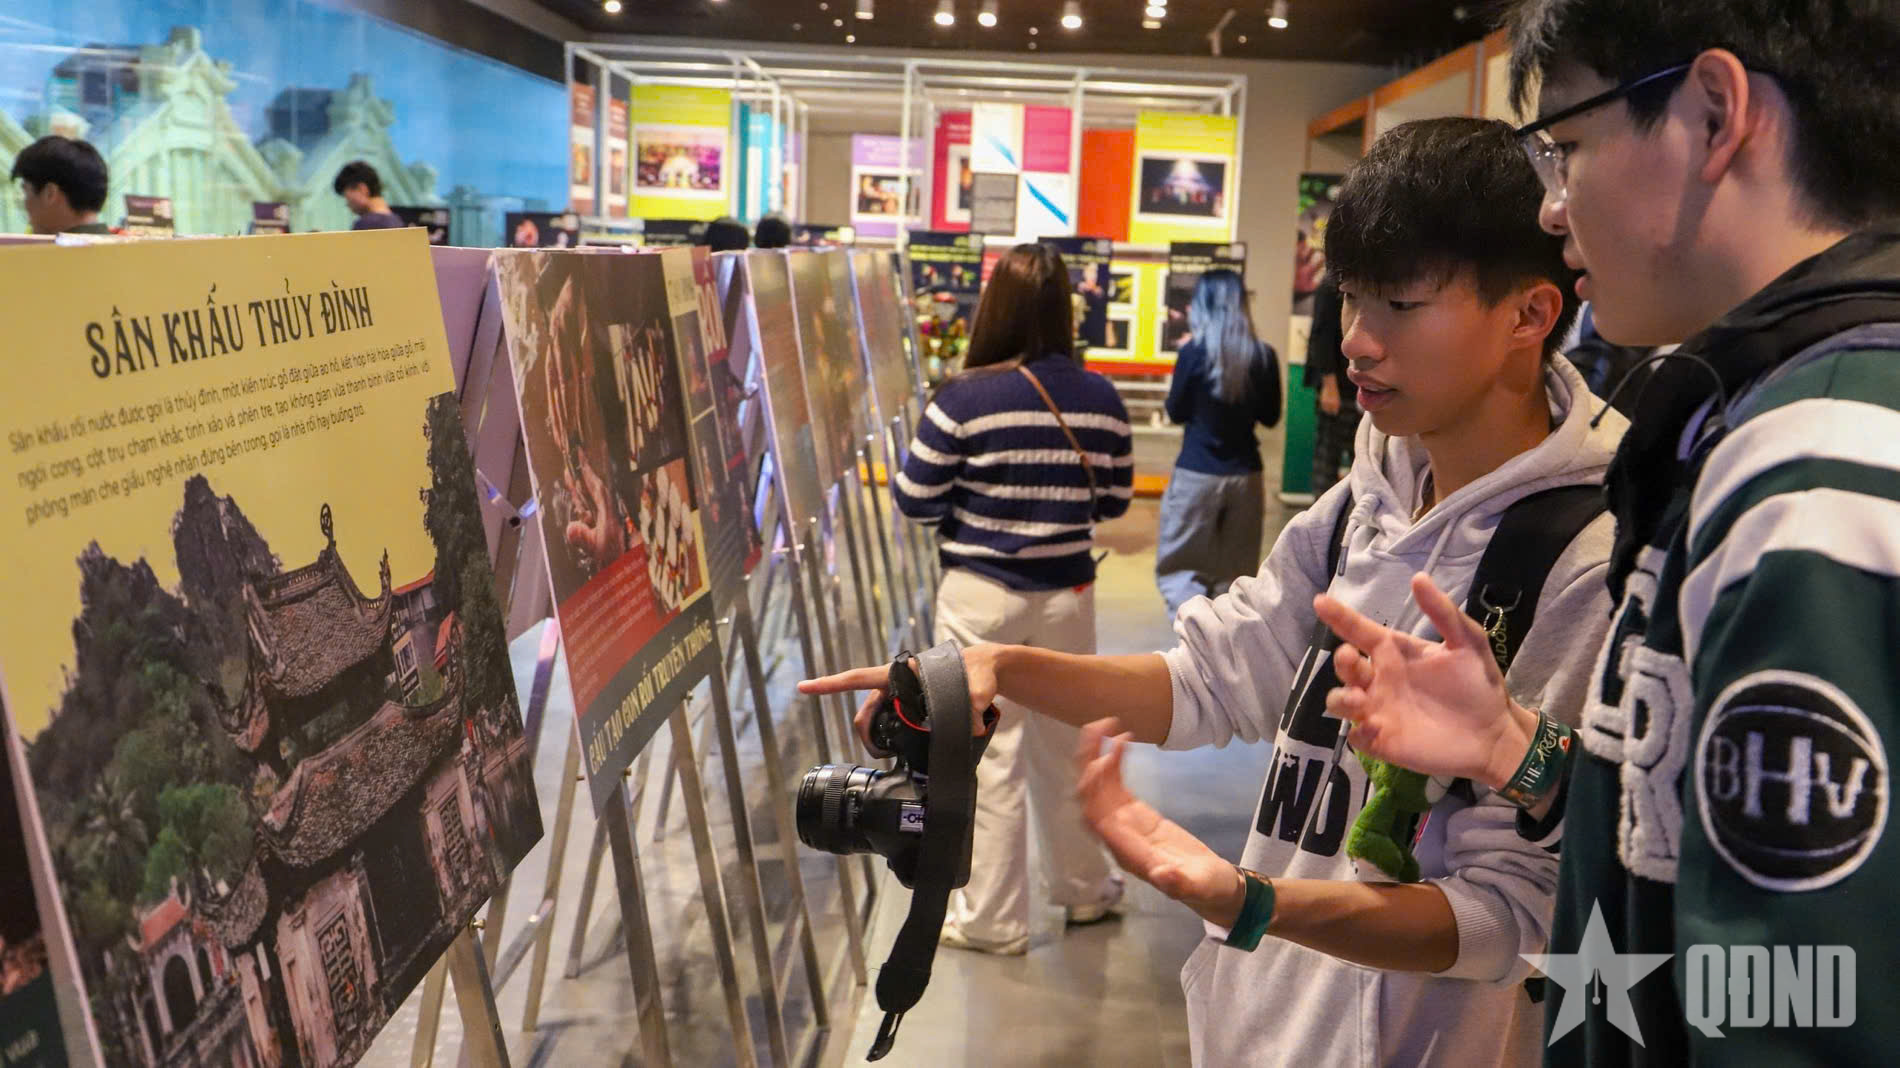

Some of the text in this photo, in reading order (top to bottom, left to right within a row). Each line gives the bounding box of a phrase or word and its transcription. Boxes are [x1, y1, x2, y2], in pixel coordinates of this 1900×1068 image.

[86, 277, 374, 379] SÂN KHẤU THỦY ĐÌNH
[8, 429, 35, 456] Sân
[36, 419, 69, 445] khấu
[88, 410, 116, 431] nước
[118, 405, 144, 426] được
[146, 402, 161, 423] gọi
[163, 395, 174, 414] là
[222, 382, 241, 399] một
[241, 377, 259, 393] kiến
[259, 373, 277, 392] trúc
[278, 368, 288, 389] gỗ
[289, 367, 301, 384] đặt
[302, 363, 319, 383] giữa
[319, 364, 329, 377] ao
[86, 448, 105, 470] cột
[127, 436, 157, 457] chạm
[160, 424, 183, 446] khắc
[207, 414, 223, 433] xảo
[224, 410, 235, 428] và
[290, 391, 314, 408] không
[315, 388, 331, 406] gian
[332, 382, 346, 398] vừa
[98, 479, 119, 500] che
[120, 468, 145, 496] giấu
[146, 460, 173, 486] nghệ
[174, 453, 199, 474] nhân
[200, 447, 226, 465] đứng
[226, 439, 244, 459] bên
[269, 428, 281, 449] gọi
[281, 424, 290, 440] là
[317, 413, 330, 430] hay
